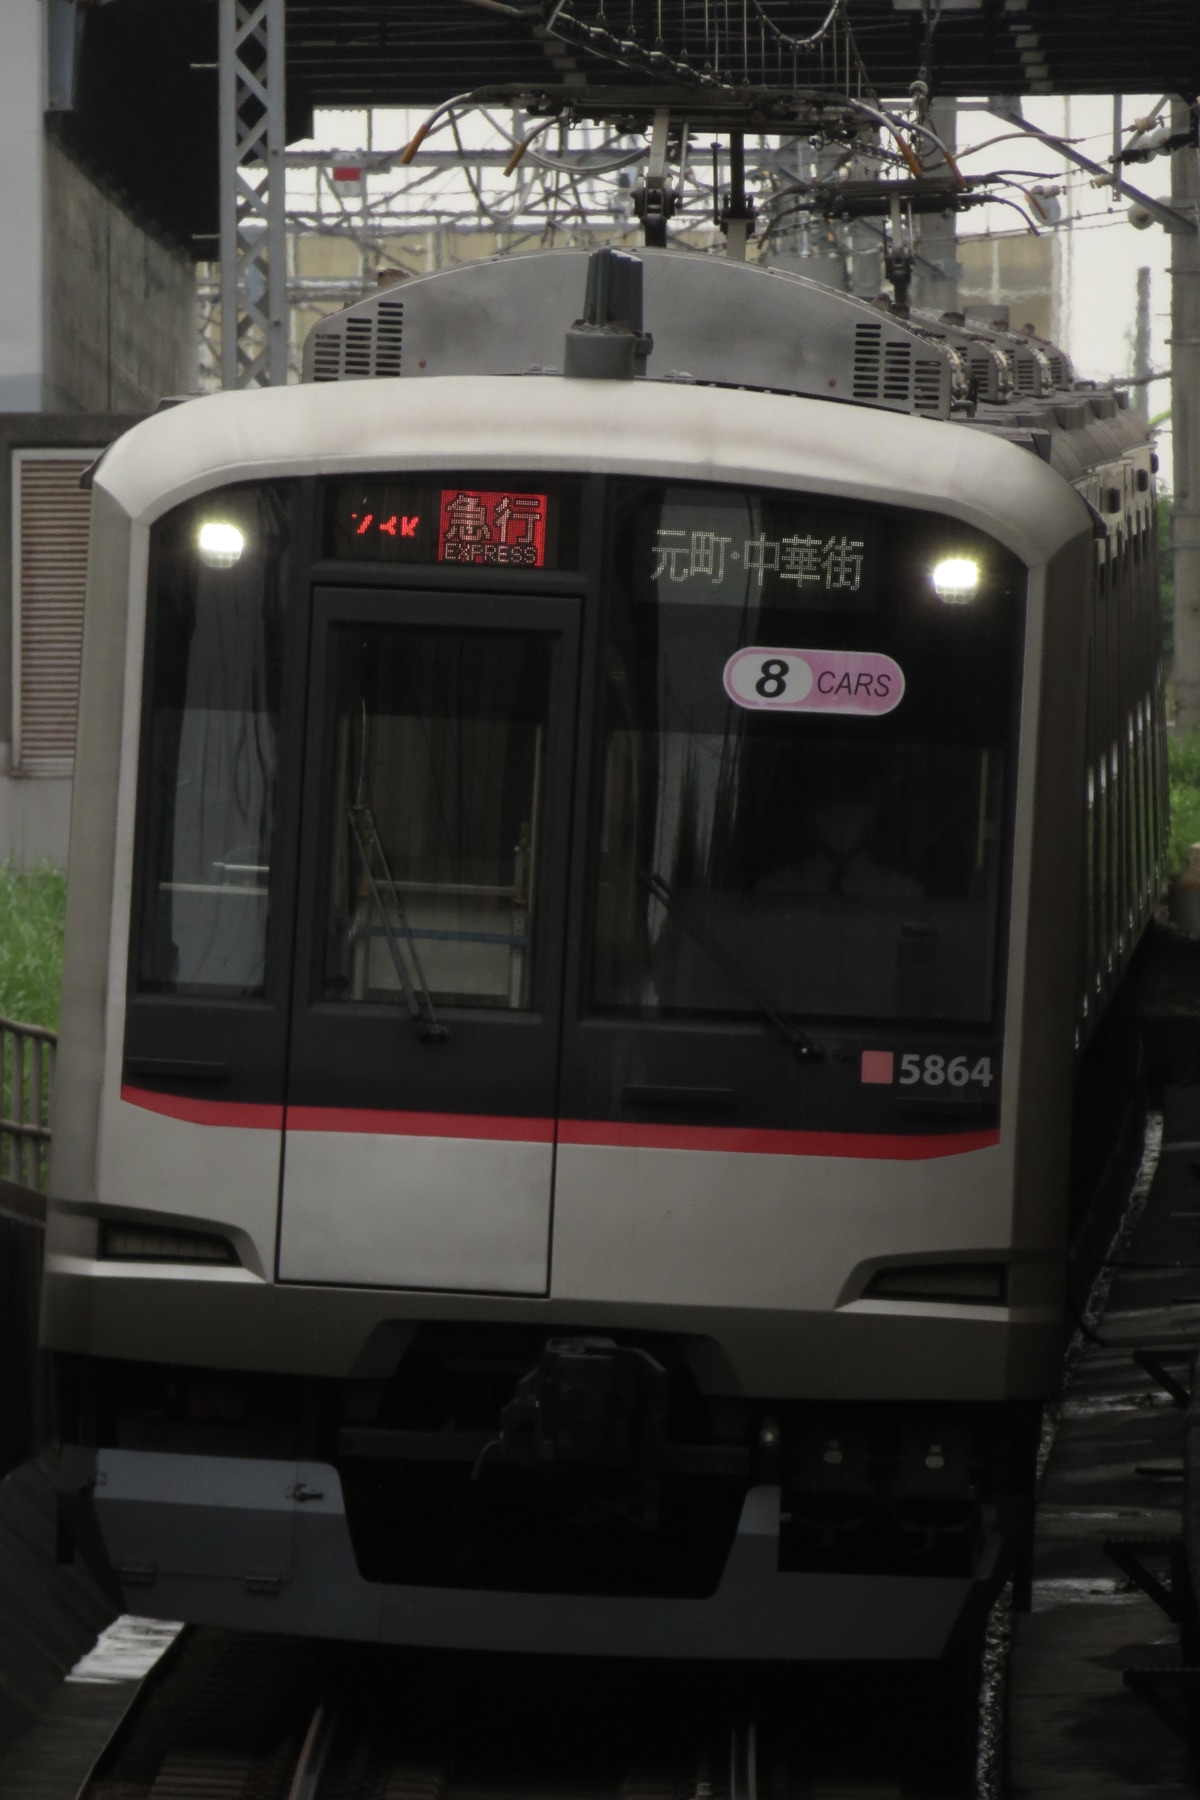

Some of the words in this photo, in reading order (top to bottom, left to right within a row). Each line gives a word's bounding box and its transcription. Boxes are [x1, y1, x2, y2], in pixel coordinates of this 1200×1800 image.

[445, 493, 541, 544] 急行
[444, 543, 537, 564] EXPRESS
[755, 658, 790, 698] 8
[816, 670, 892, 697] CARS
[898, 1053, 994, 1088] 5864
